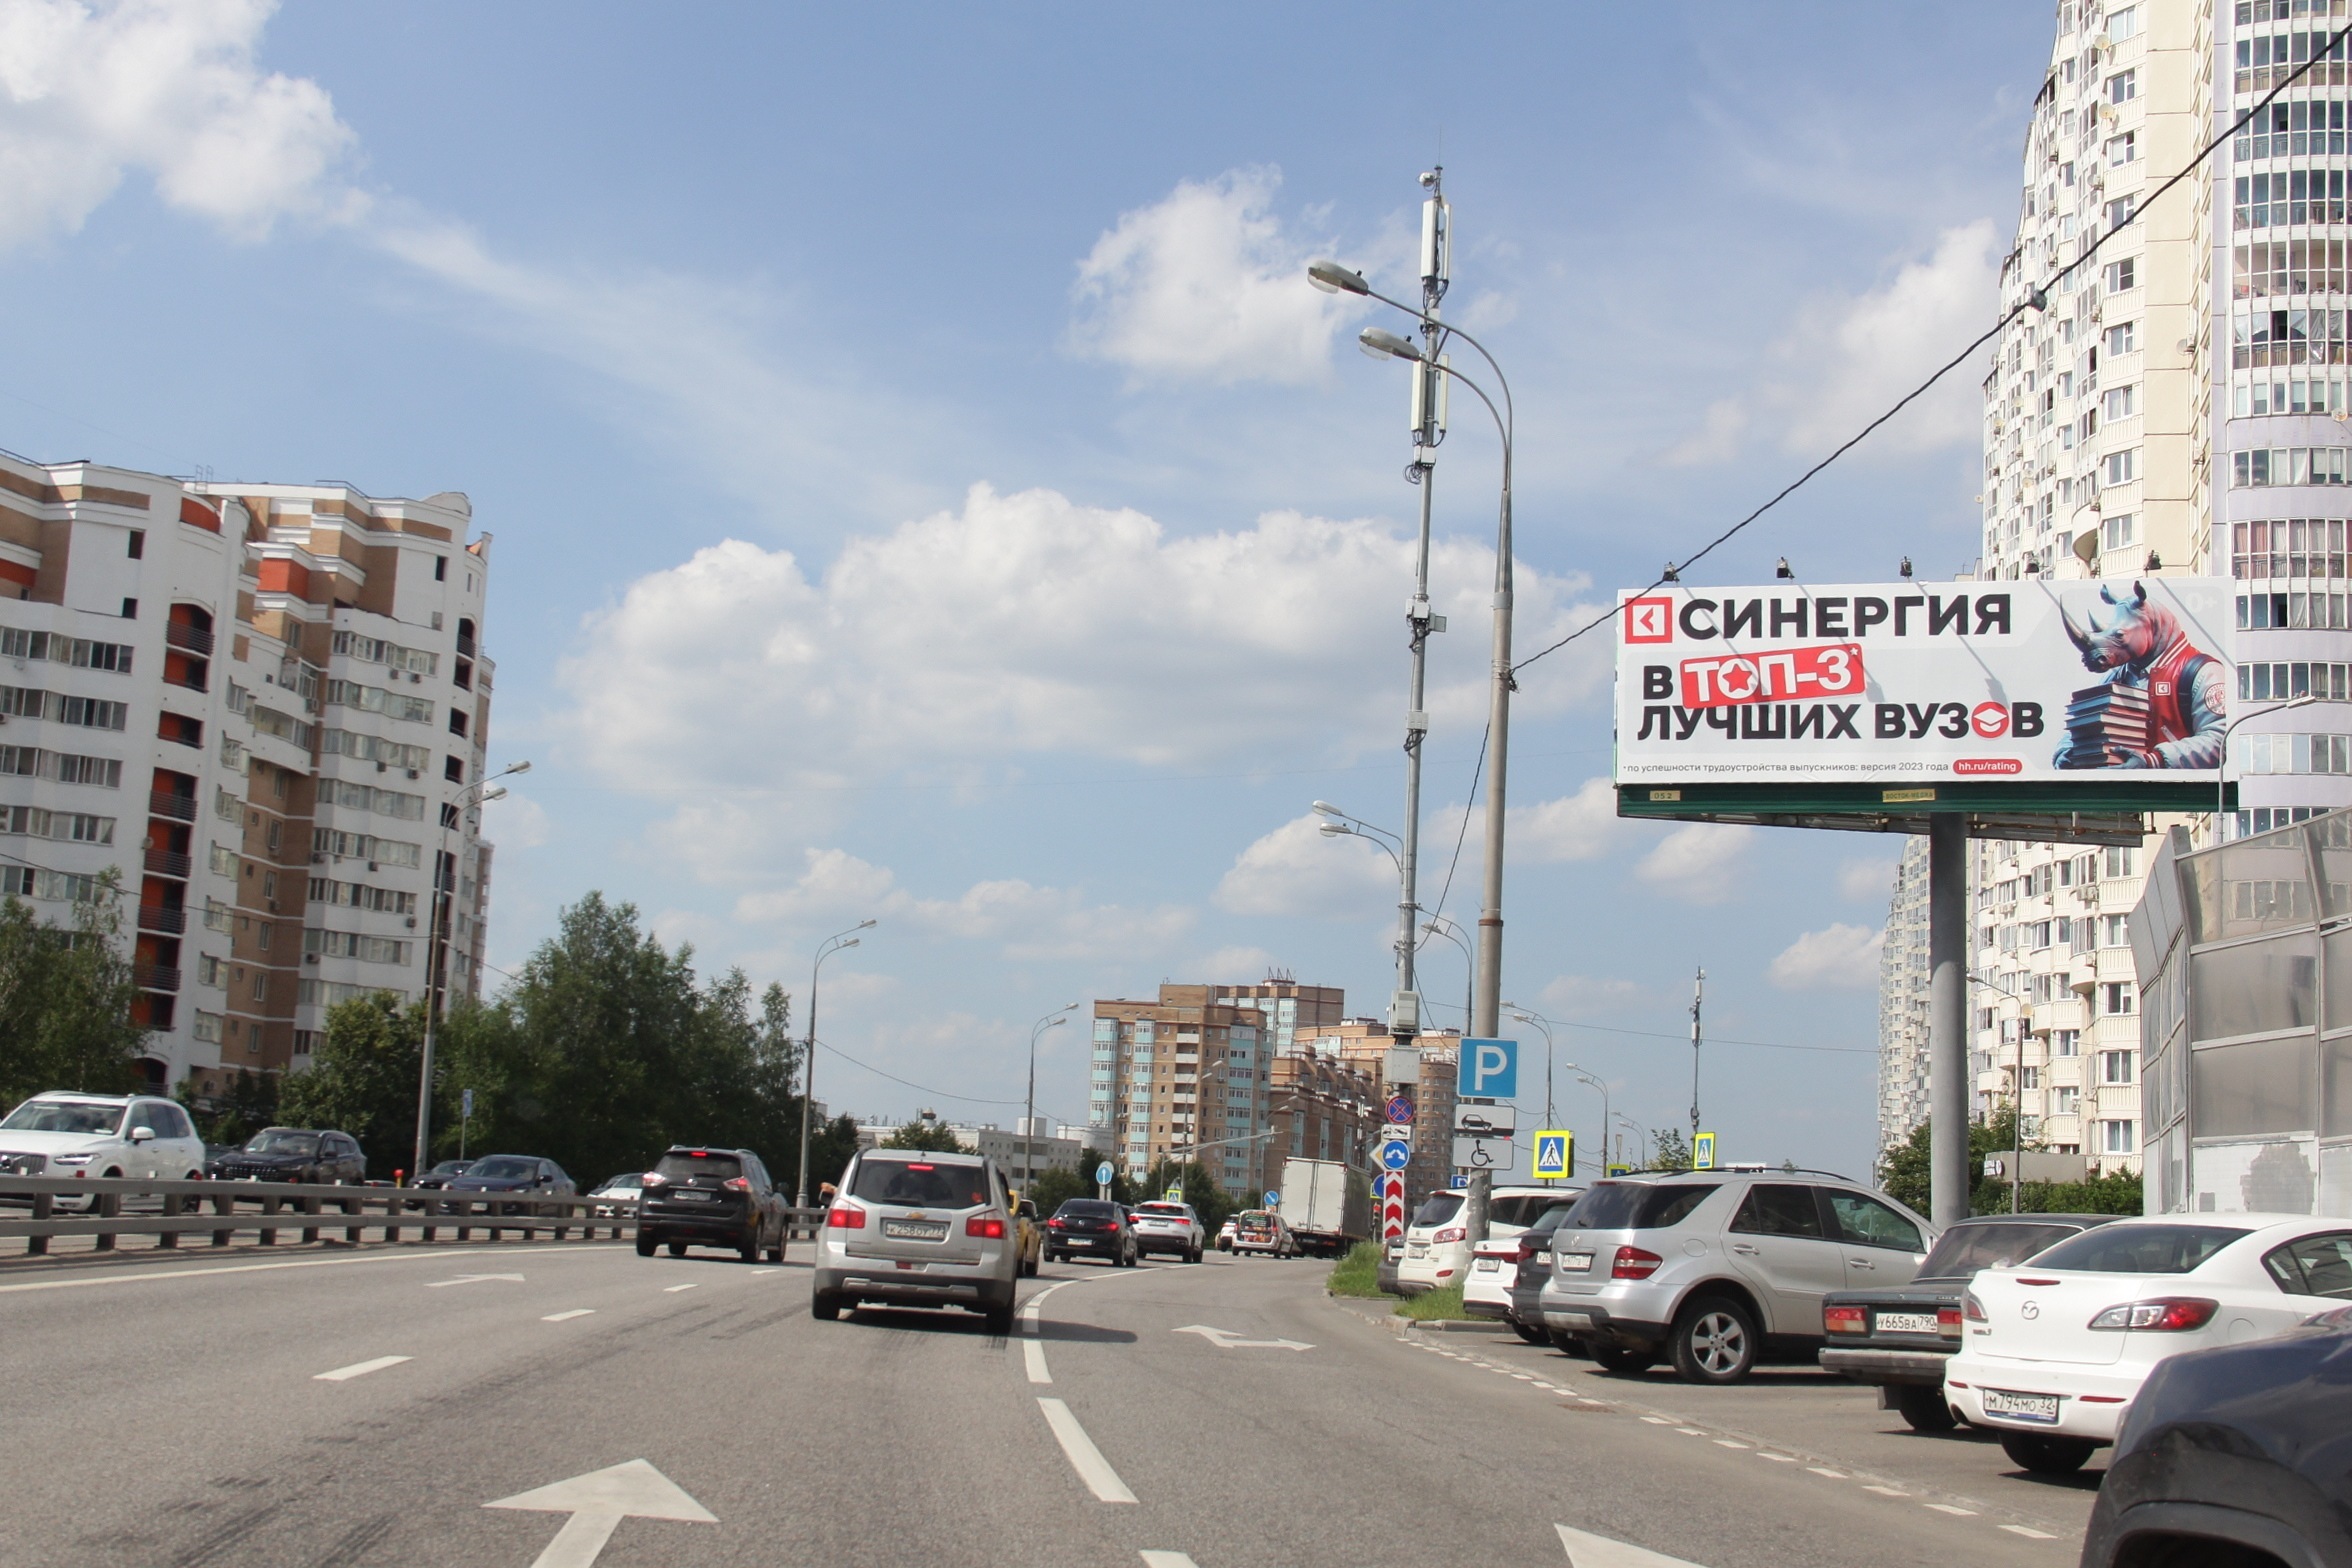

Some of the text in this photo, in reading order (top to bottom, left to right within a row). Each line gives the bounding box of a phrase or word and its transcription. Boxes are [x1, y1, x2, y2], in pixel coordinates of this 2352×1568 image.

[1679, 594, 2011, 640] СИНЕРГИЯ
[1643, 665, 1674, 700] В
[1637, 701, 2044, 741] ЛУЧШИХ ВУЗОВ
[1641, 764, 1701, 774] успешности
[1703, 762, 1788, 774] трудоустройства
[1789, 763, 1859, 774] выпускников:
[1860, 763, 1897, 774] версия
[1898, 761, 1924, 772] 2023
[1925, 764, 1949, 773] года
[1958, 761, 2017, 773] hh.ru/rating
[1653, 792, 1673, 800] 052
[1474, 1045, 1507, 1091] P
[1880, 1315, 1918, 1330] У665ВА
[1989, 1393, 2053, 1412] М794МО 32
